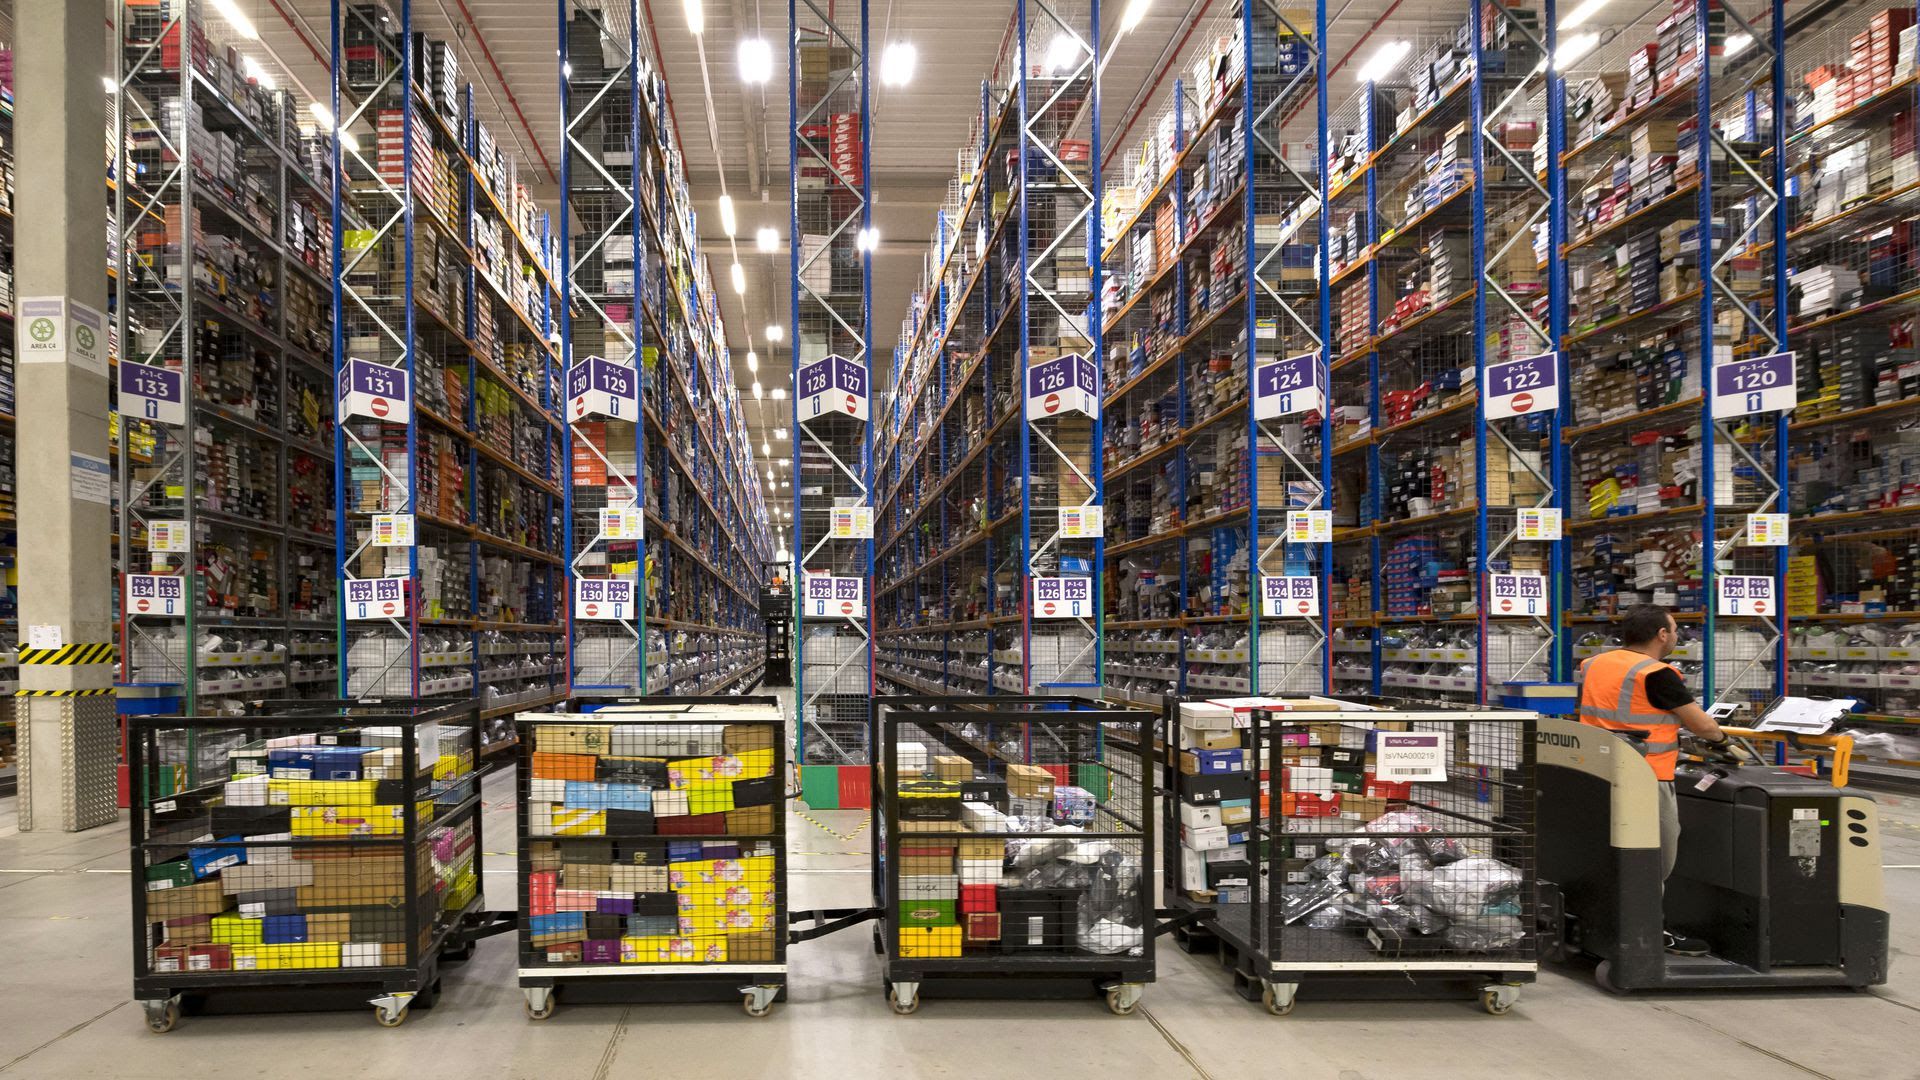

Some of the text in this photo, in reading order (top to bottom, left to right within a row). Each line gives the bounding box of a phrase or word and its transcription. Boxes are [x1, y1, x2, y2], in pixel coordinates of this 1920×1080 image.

[76, 347, 89, 357] AREA
[369, 367, 390, 377] P-1-C
[606, 366, 622, 376] P-1-C
[809, 366, 822, 376] P-1-C
[844, 366, 857, 376] P-1-C
[1042, 363, 1061, 375] P-1-C
[1274, 362, 1297, 374] P-1-C
[1508, 362, 1534, 374] P-1-C
[1739, 361, 1769, 374] P-1-C
[140, 369, 163, 380] P-1-C
[1733, 370, 1777, 390] 120
[365, 377, 393, 396] 131
[573, 375, 586, 393] 130
[603, 375, 627, 393] 129
[806, 374, 826, 392] 128
[843, 374, 860, 391] 127
[1038, 373, 1065, 392] 126
[1081, 373, 1094, 391] 125
[1270, 371, 1302, 391] 124
[1503, 371, 1541, 391] 122
[135, 379, 169, 397] 133
[133, 585, 154, 596] 134
[159, 586, 180, 597] 133
[351, 590, 372, 601] 132
[378, 589, 398, 600] 131
[581, 590, 603, 601] 130
[608, 590, 629, 601] 129
[810, 587, 831, 598] 128
[837, 588, 857, 598] 127
[1039, 588, 1059, 599] 126
[1065, 588, 1086, 599] 125
[1267, 587, 1287, 598] 124
[1293, 587, 1313, 598] 123
[1496, 586, 1516, 596] 122
[1521, 586, 1541, 597] 121
[1724, 586, 1744, 597] 120
[1749, 587, 1770, 597] 119
